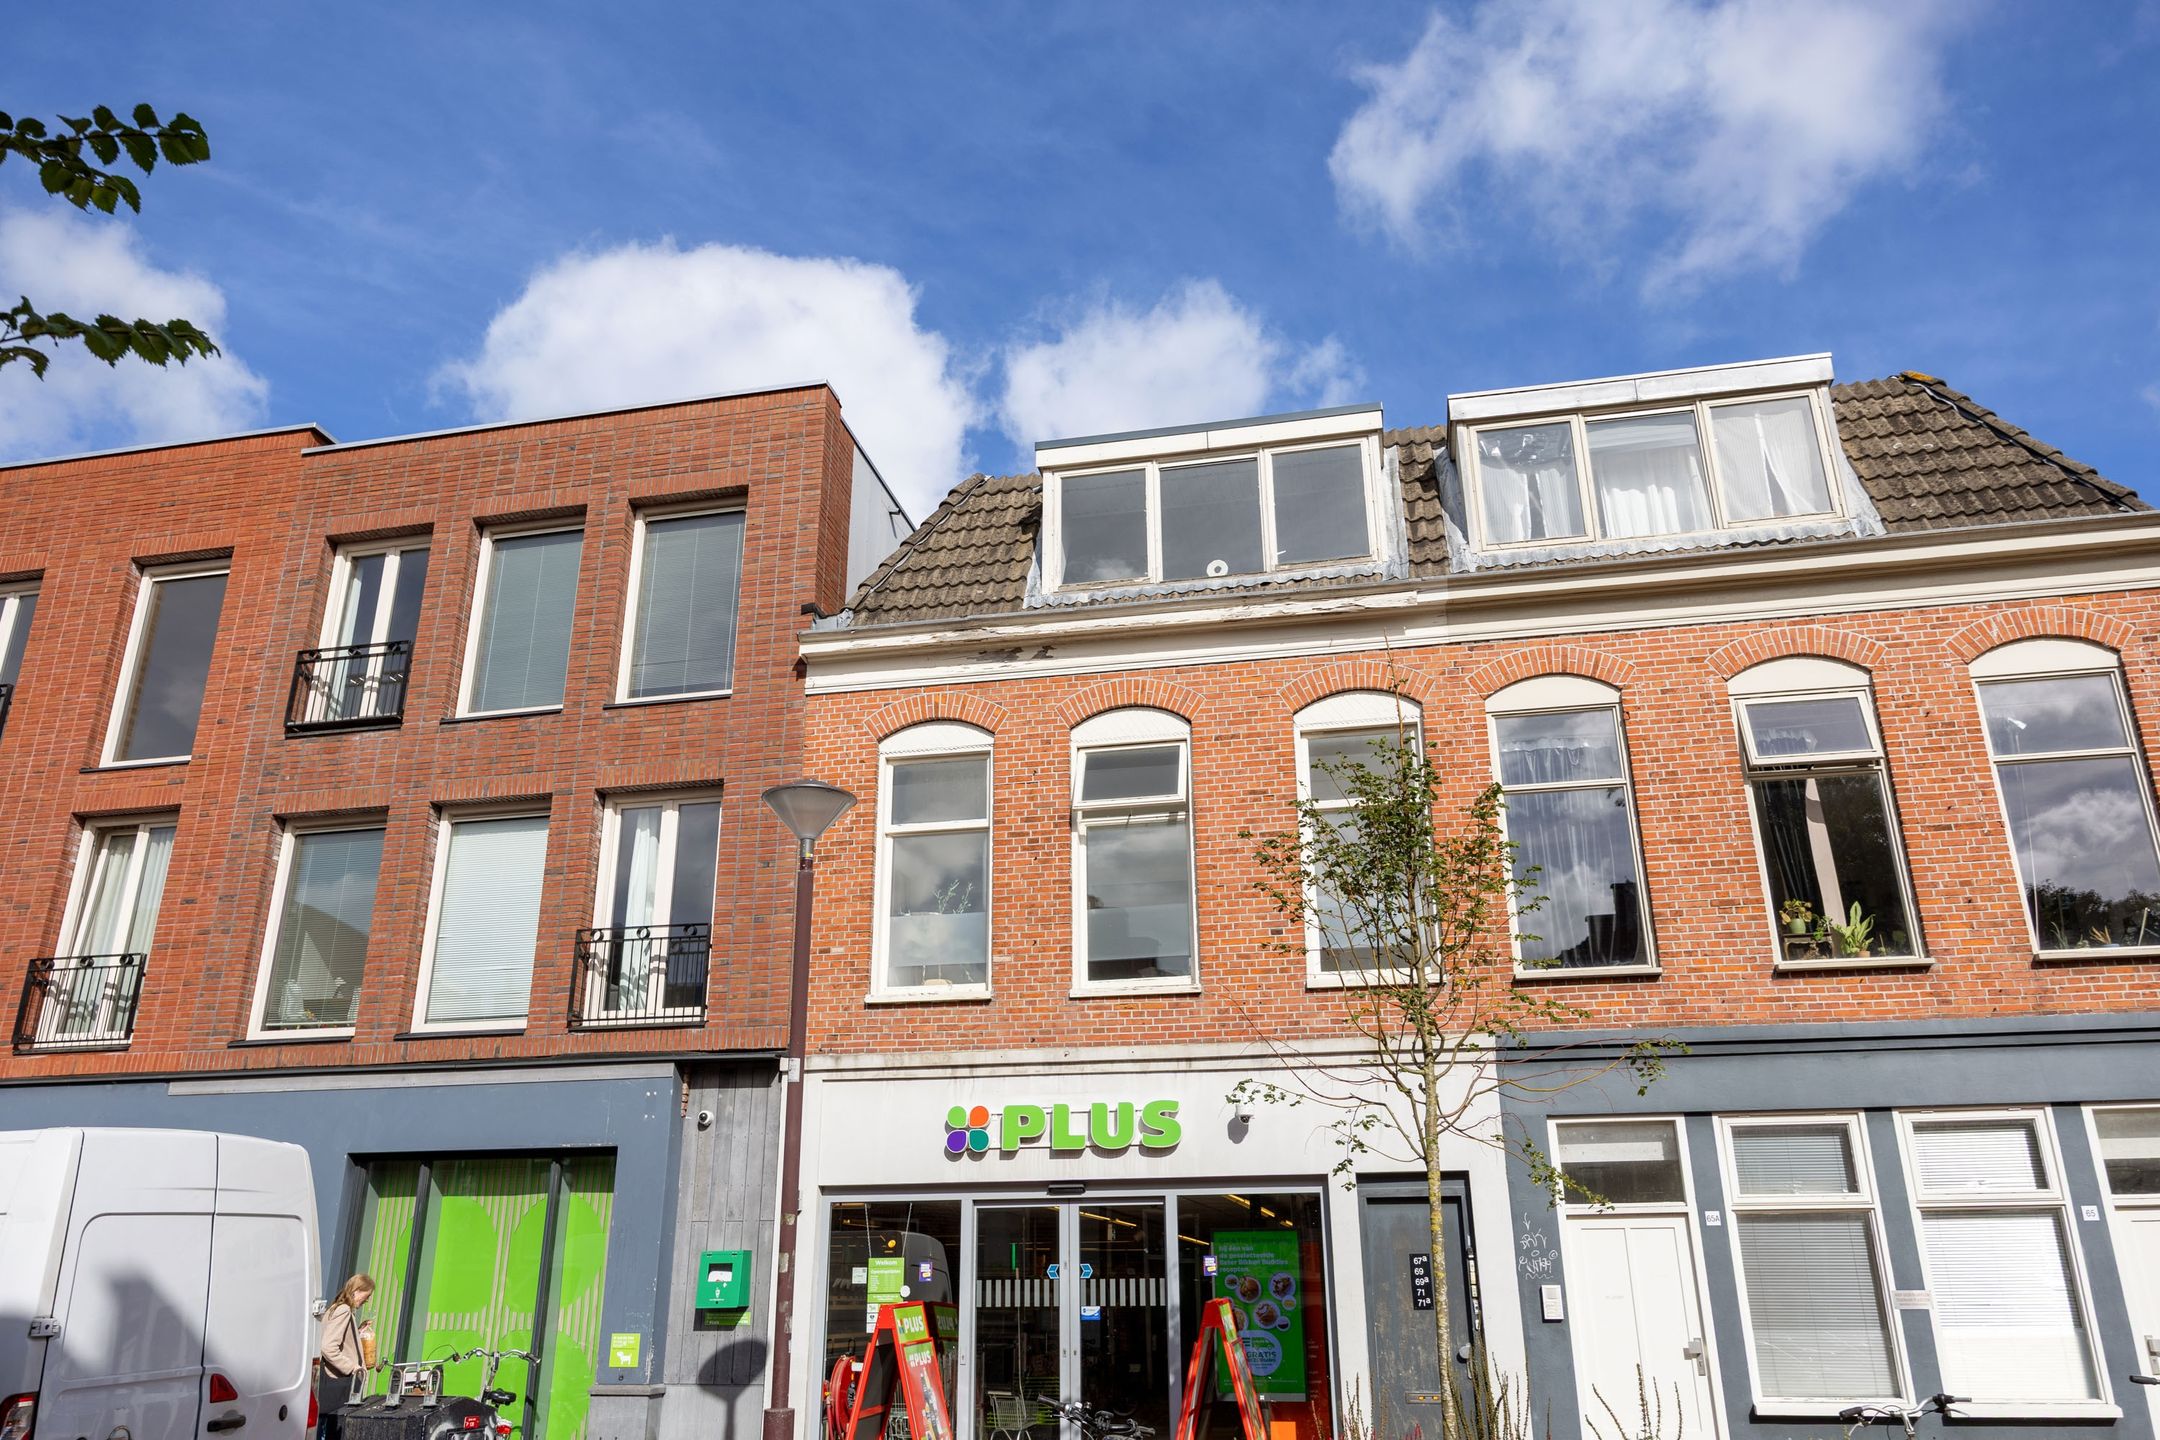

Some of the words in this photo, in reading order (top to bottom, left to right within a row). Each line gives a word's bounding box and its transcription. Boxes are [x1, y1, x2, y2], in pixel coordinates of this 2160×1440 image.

[1001, 1100, 1182, 1151] PLUS
[2085, 1209, 2096, 1217] 65
[1706, 1214, 1720, 1222] 65A
[1413, 1256, 1427, 1265] 67a
[1414, 1268, 1424, 1276] 69
[1415, 1277, 1429, 1286] 69a
[1417, 1298, 1431, 1307] 71a
[903, 1315, 925, 1334] PLUS
[914, 1350, 932, 1367] PLUS
